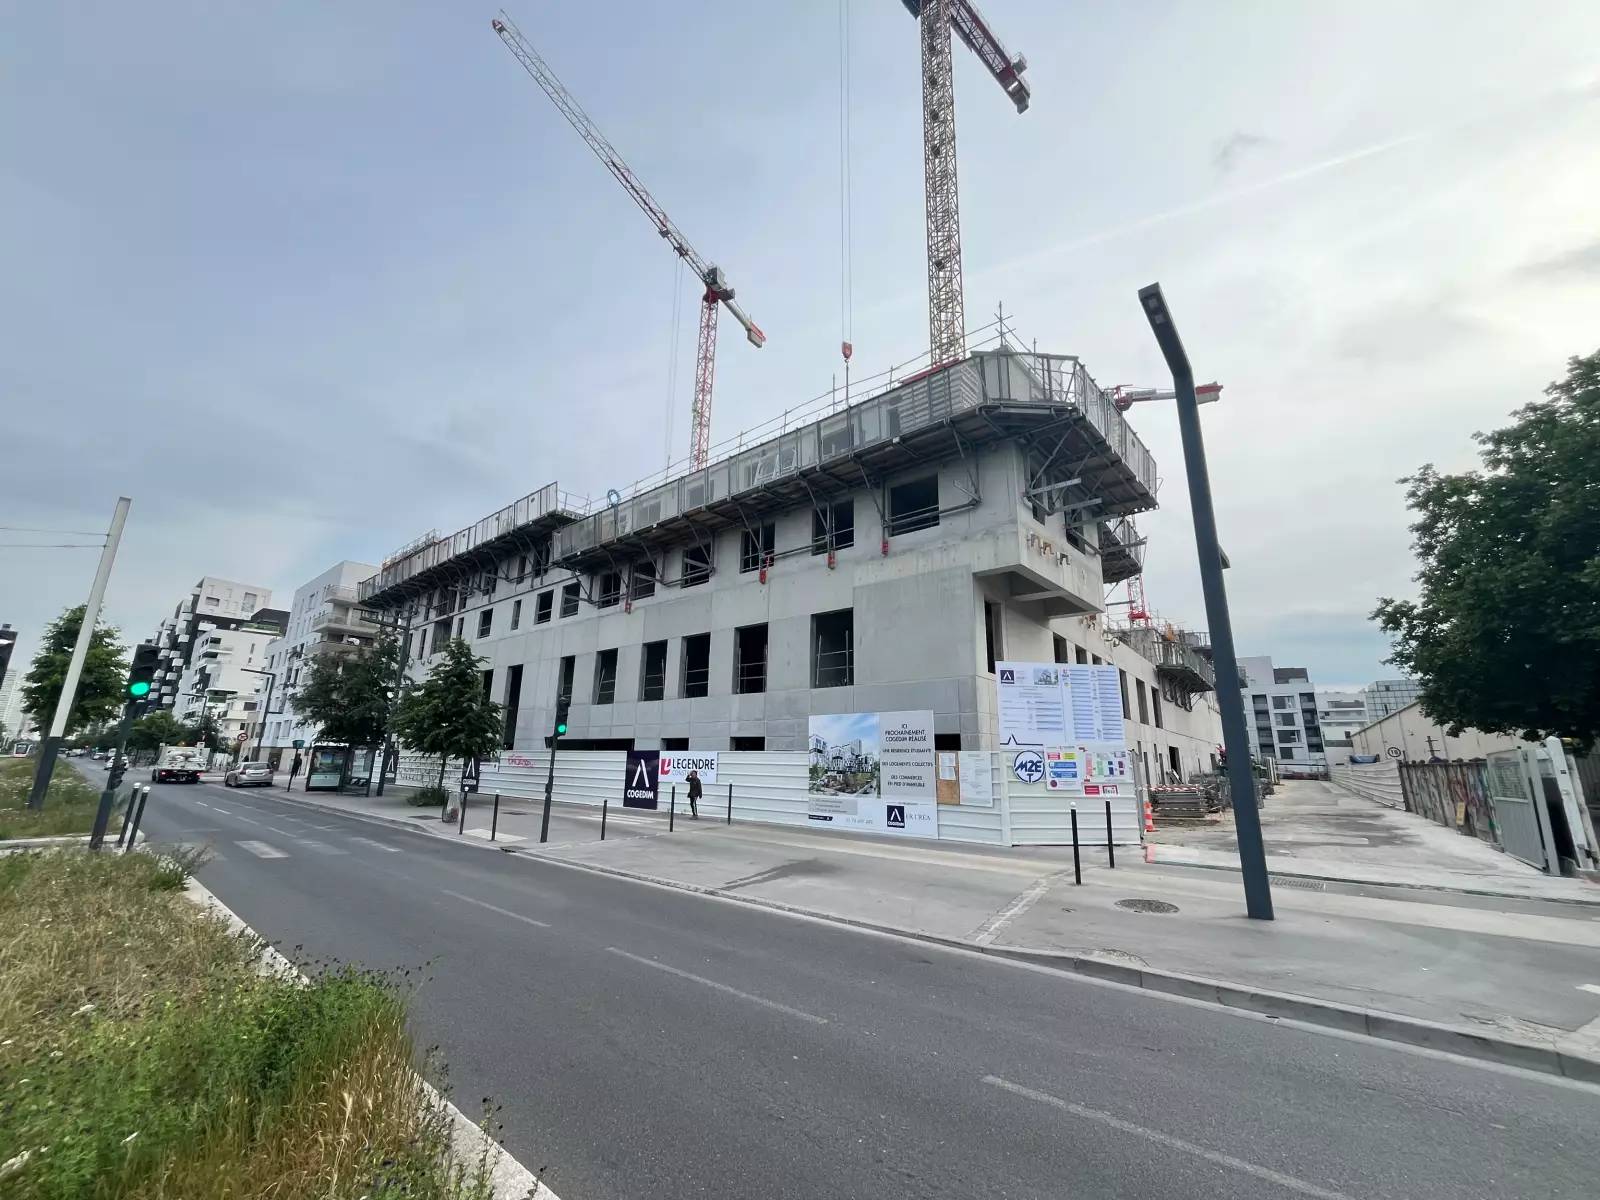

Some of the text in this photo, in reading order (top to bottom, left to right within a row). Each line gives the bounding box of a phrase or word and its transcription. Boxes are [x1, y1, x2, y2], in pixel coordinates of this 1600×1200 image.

[672, 758, 715, 770] LEGENDRE
[1014, 760, 1043, 773] M2E
[626, 789, 654, 799] COGEDIM
